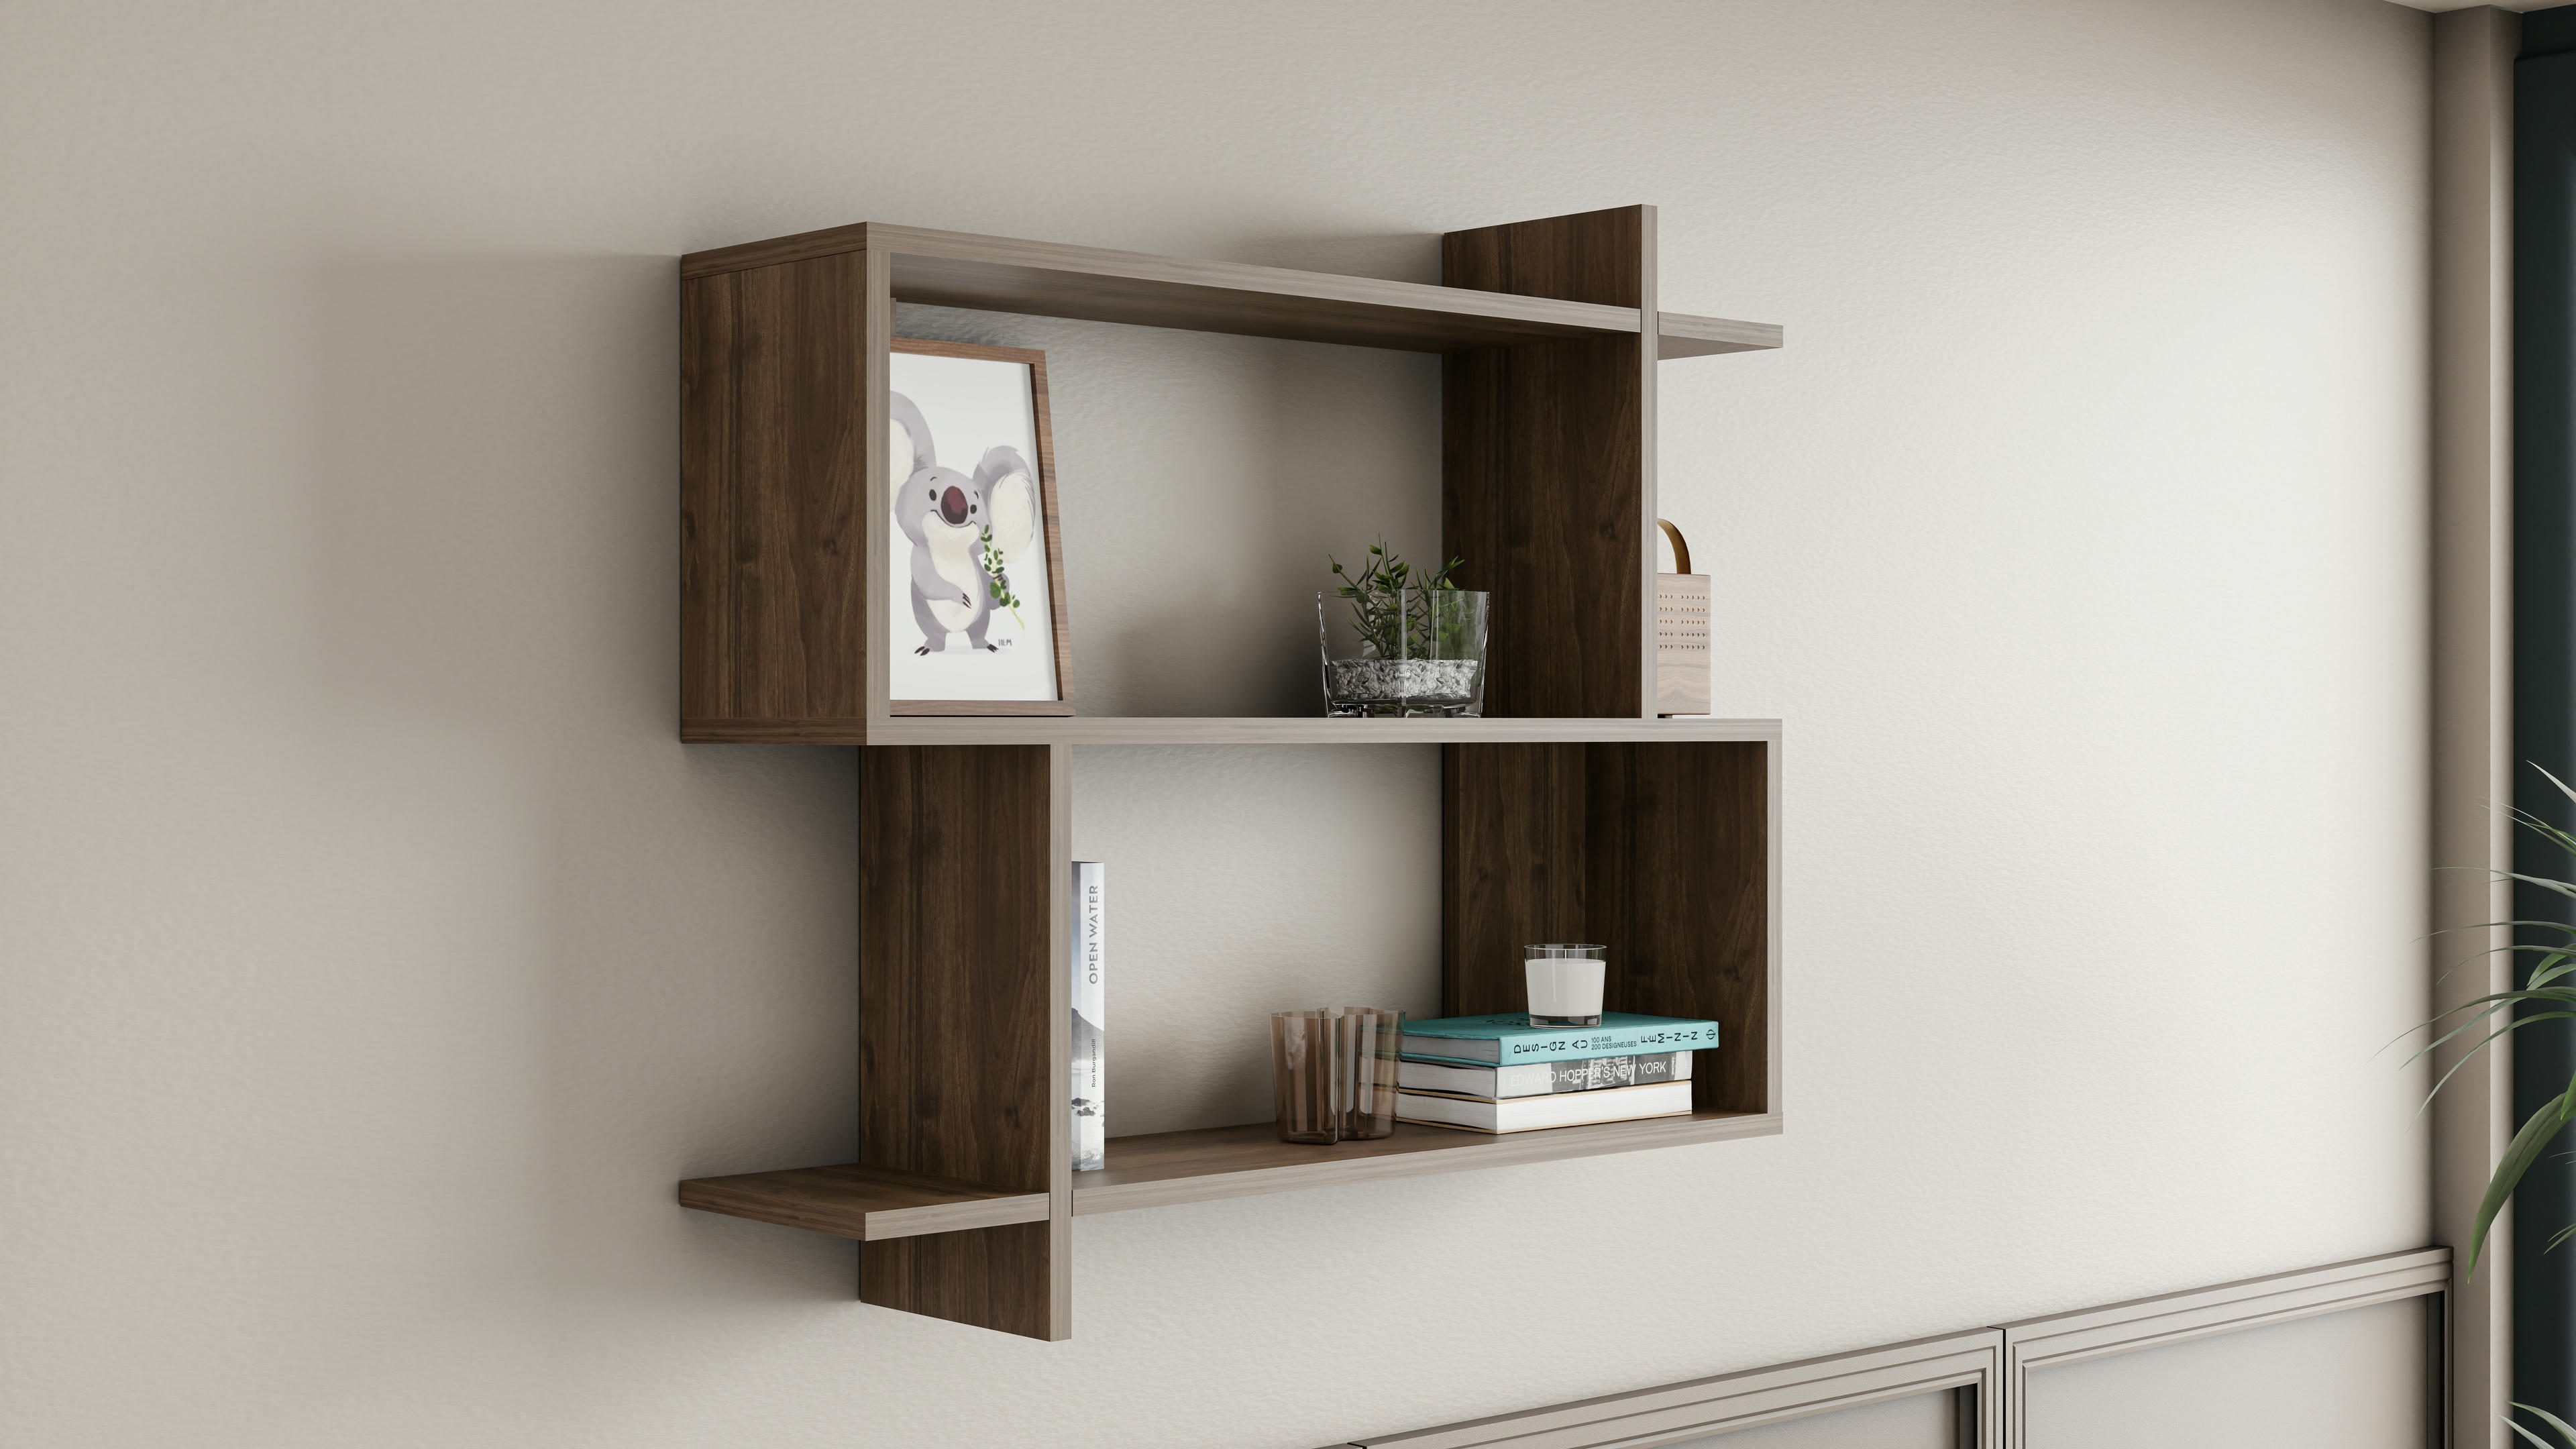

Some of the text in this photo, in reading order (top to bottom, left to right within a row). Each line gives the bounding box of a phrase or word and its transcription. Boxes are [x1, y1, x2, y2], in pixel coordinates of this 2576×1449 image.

[1089, 885, 1098, 984] OPEN WATER
[1513, 1040, 1588, 1054] DESIGN AU
[1602, 1040, 1637, 1049] DESIGNEUSES
[1511, 1061, 1666, 1087] EDWARD HOPPER'S NEW YORK
